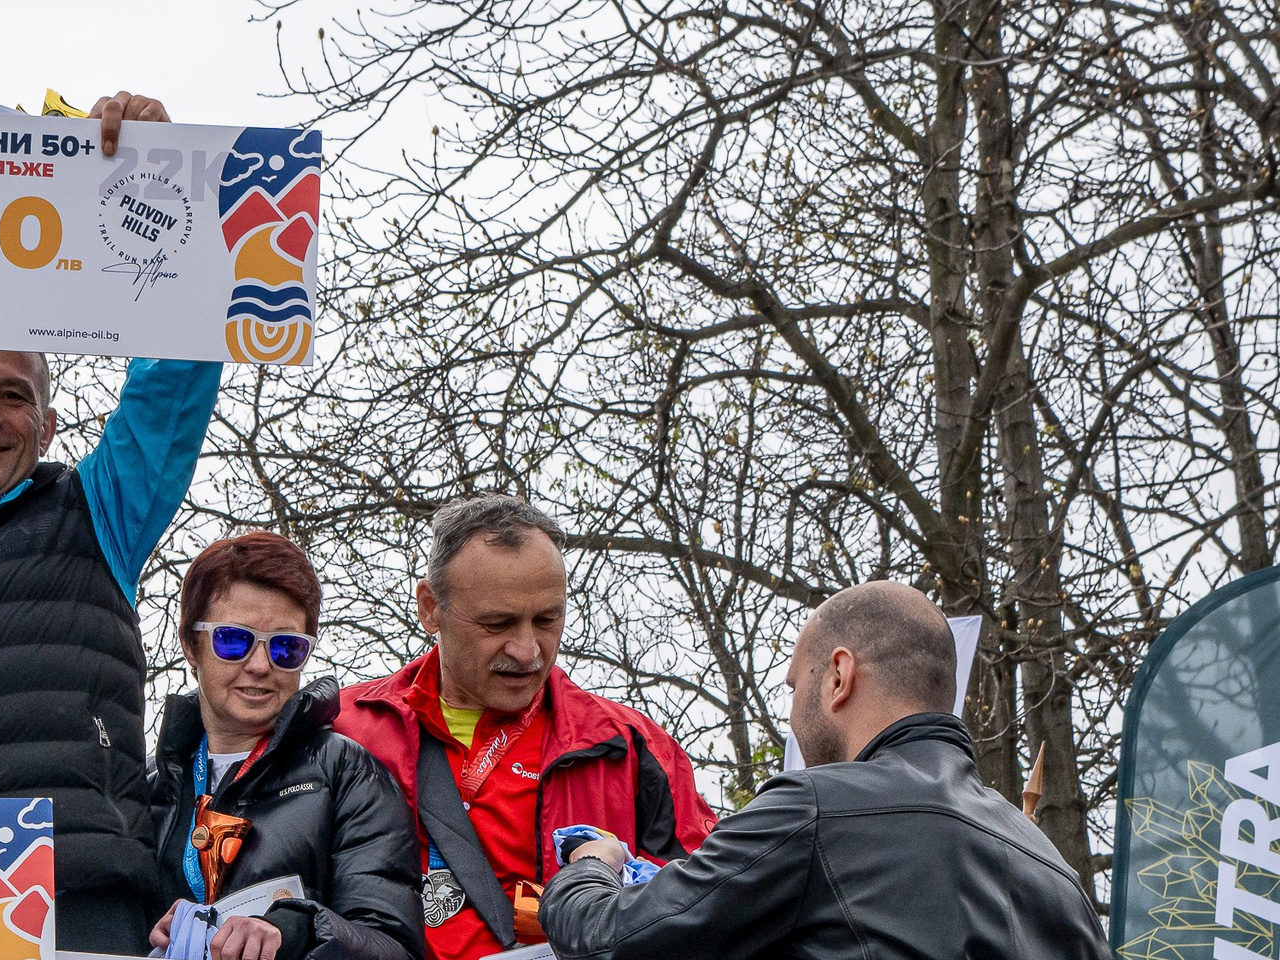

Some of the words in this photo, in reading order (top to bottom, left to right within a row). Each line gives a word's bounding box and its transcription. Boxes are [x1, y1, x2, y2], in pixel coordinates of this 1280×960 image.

[41, 135, 96, 158] 50+
[100, 174, 135, 206] PLOVDIV
[140, 172, 170, 185] HILLS
[172, 183, 183, 195] IN
[180, 197, 193, 245] MARKOVO
[119, 194, 178, 231] PLOVDIV
[120, 214, 160, 243] HILLS
[98, 223, 116, 251] TRAIL
[118, 251, 137, 264] RUN
[55, 258, 83, 271] лв
[28, 325, 120, 343] www.alpine-oil.bg
